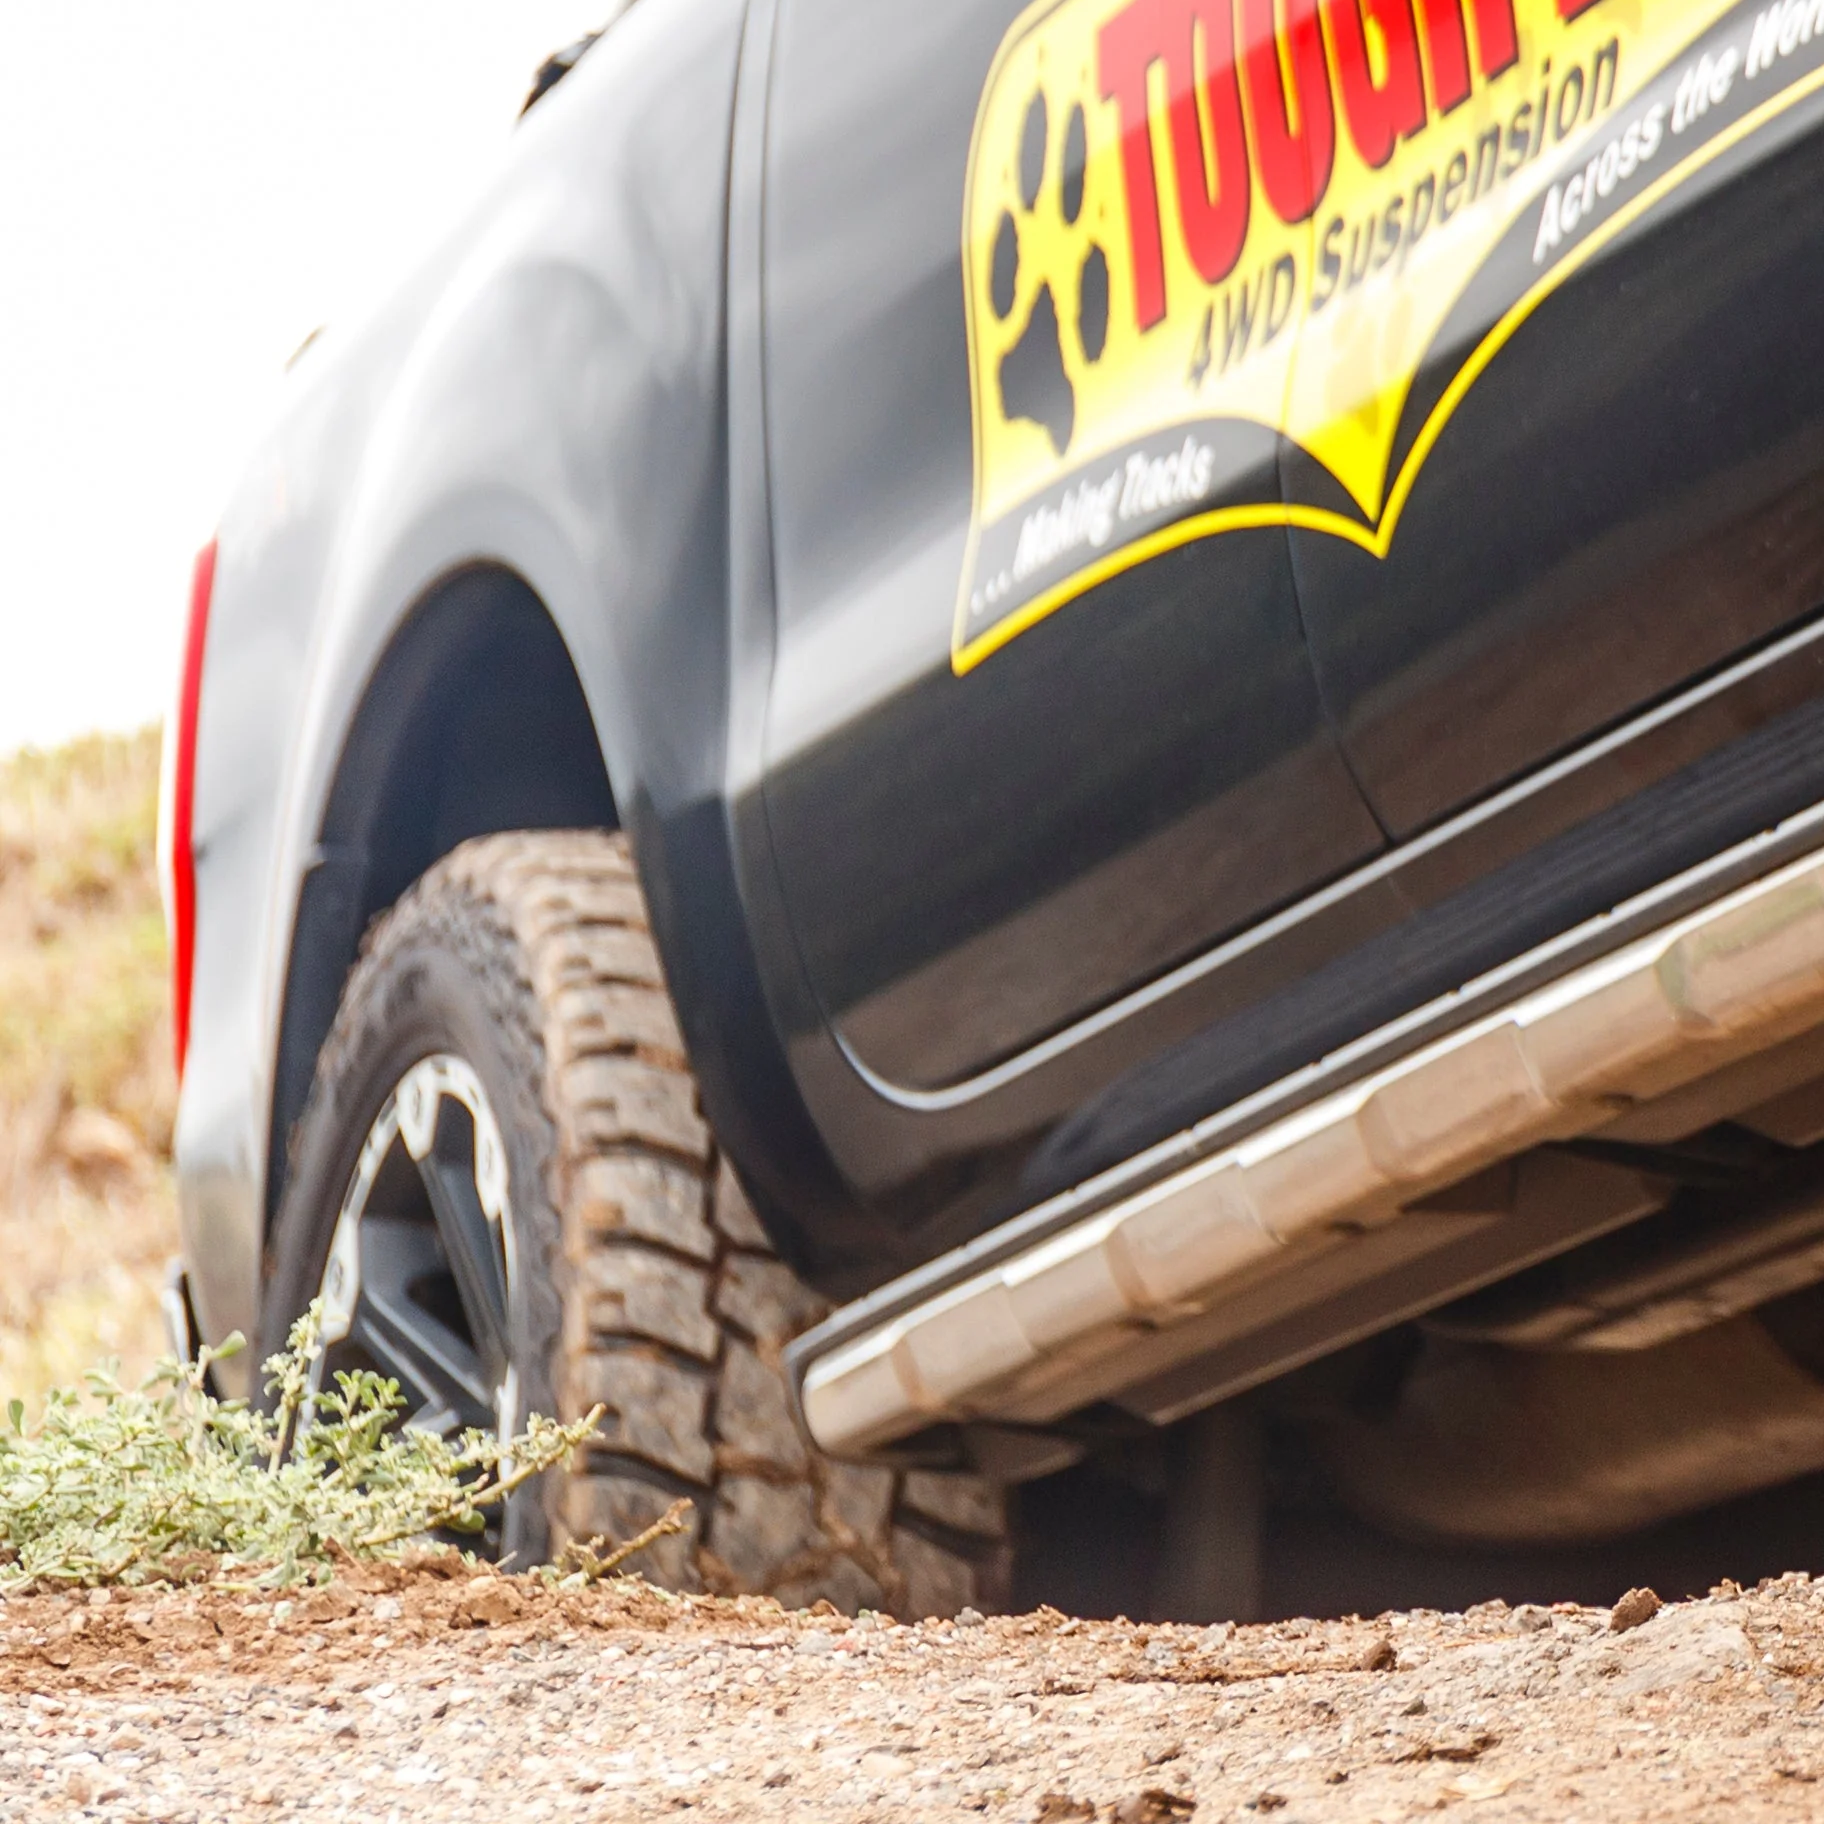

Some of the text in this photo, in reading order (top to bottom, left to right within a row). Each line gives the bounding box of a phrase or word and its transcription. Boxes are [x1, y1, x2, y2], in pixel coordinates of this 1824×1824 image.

[1188, 36, 1618, 391] 4WD Suspension
[1533, 101, 1666, 265] Across
[1671, 45, 1740, 134] the
[1118, 434, 1217, 521] Tracks
